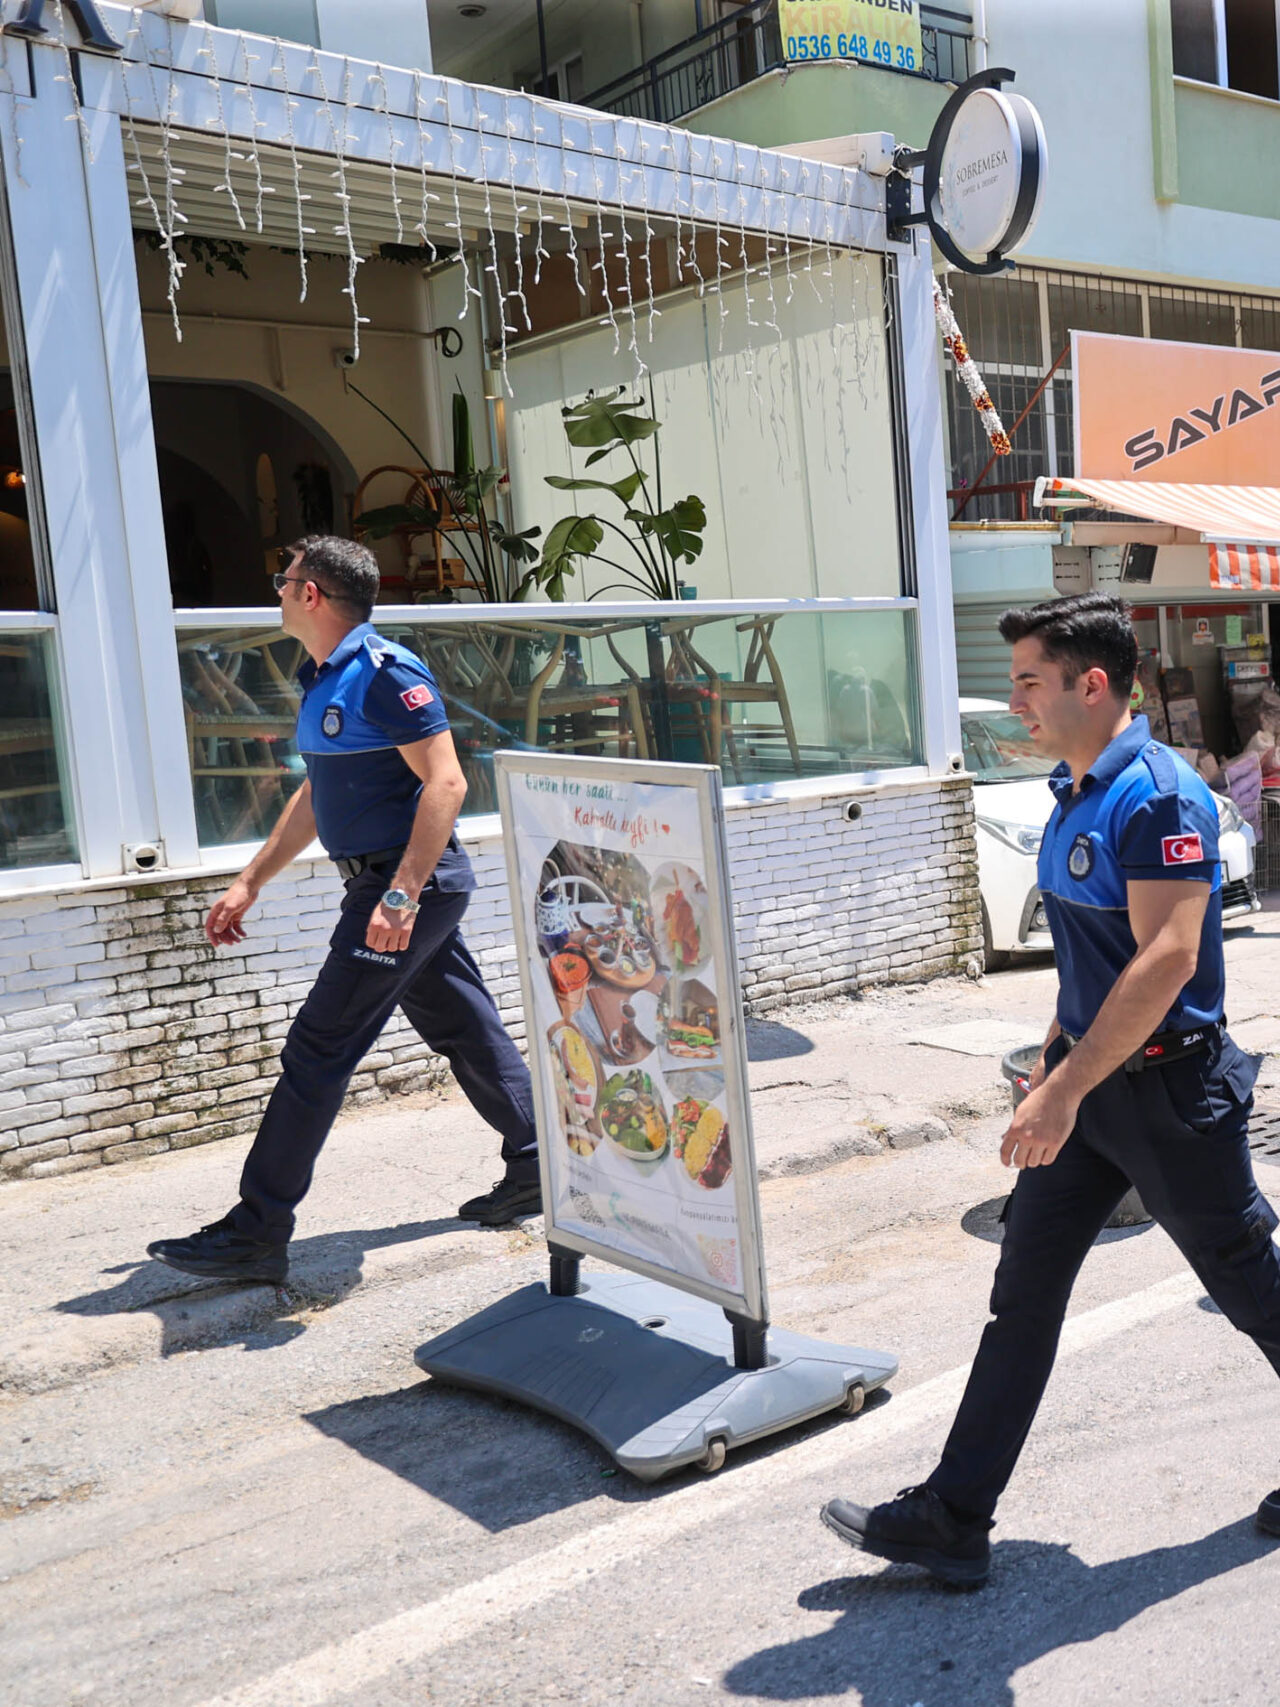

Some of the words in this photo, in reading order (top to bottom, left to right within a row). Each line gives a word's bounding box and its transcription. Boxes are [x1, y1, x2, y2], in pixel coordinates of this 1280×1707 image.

[787, 34, 831, 59] 0536
[837, 33, 868, 58] 648
[873, 39, 891, 63] 49
[896, 45, 915, 69] 36
[956, 149, 1008, 185] SOBREMESA
[562, 778, 580, 796] her
[353, 949, 396, 965] ZABITA
